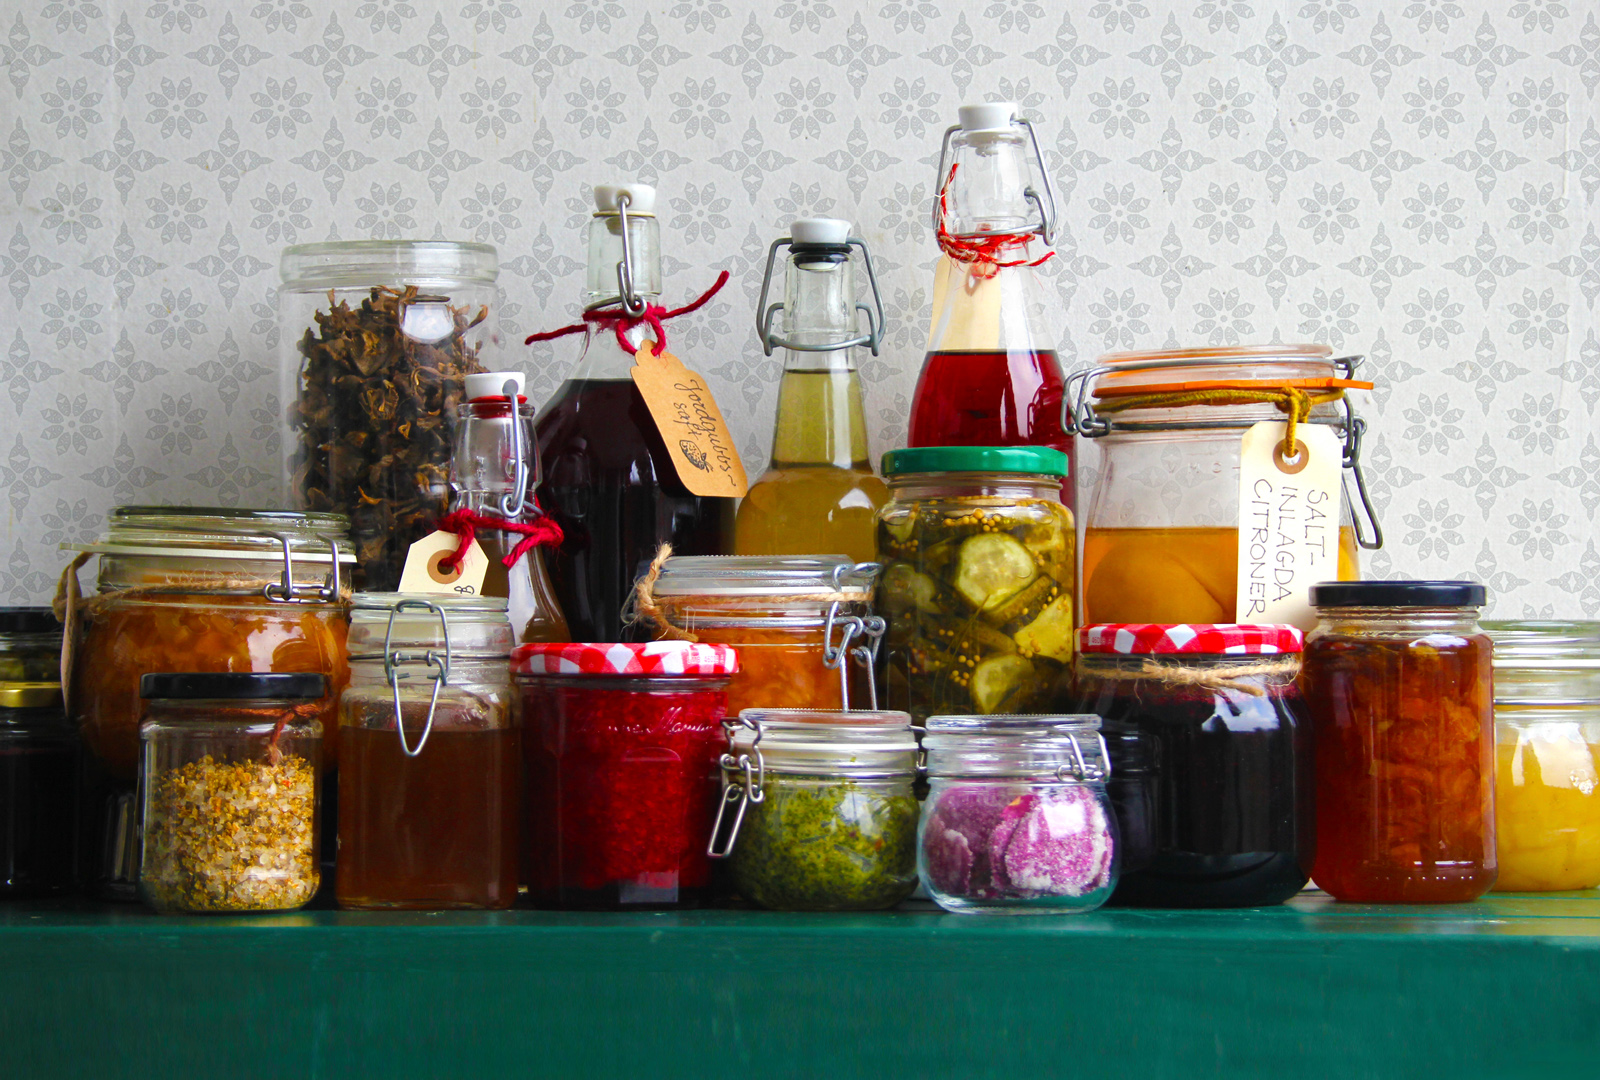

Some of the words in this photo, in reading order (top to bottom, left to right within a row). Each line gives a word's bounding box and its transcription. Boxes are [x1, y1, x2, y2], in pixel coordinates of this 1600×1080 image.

[673, 402, 703, 441] saft
[1246, 478, 1273, 618] CITRONER
[1272, 486, 1298, 602] INLAGDA
[1304, 489, 1329, 566] SALT-
